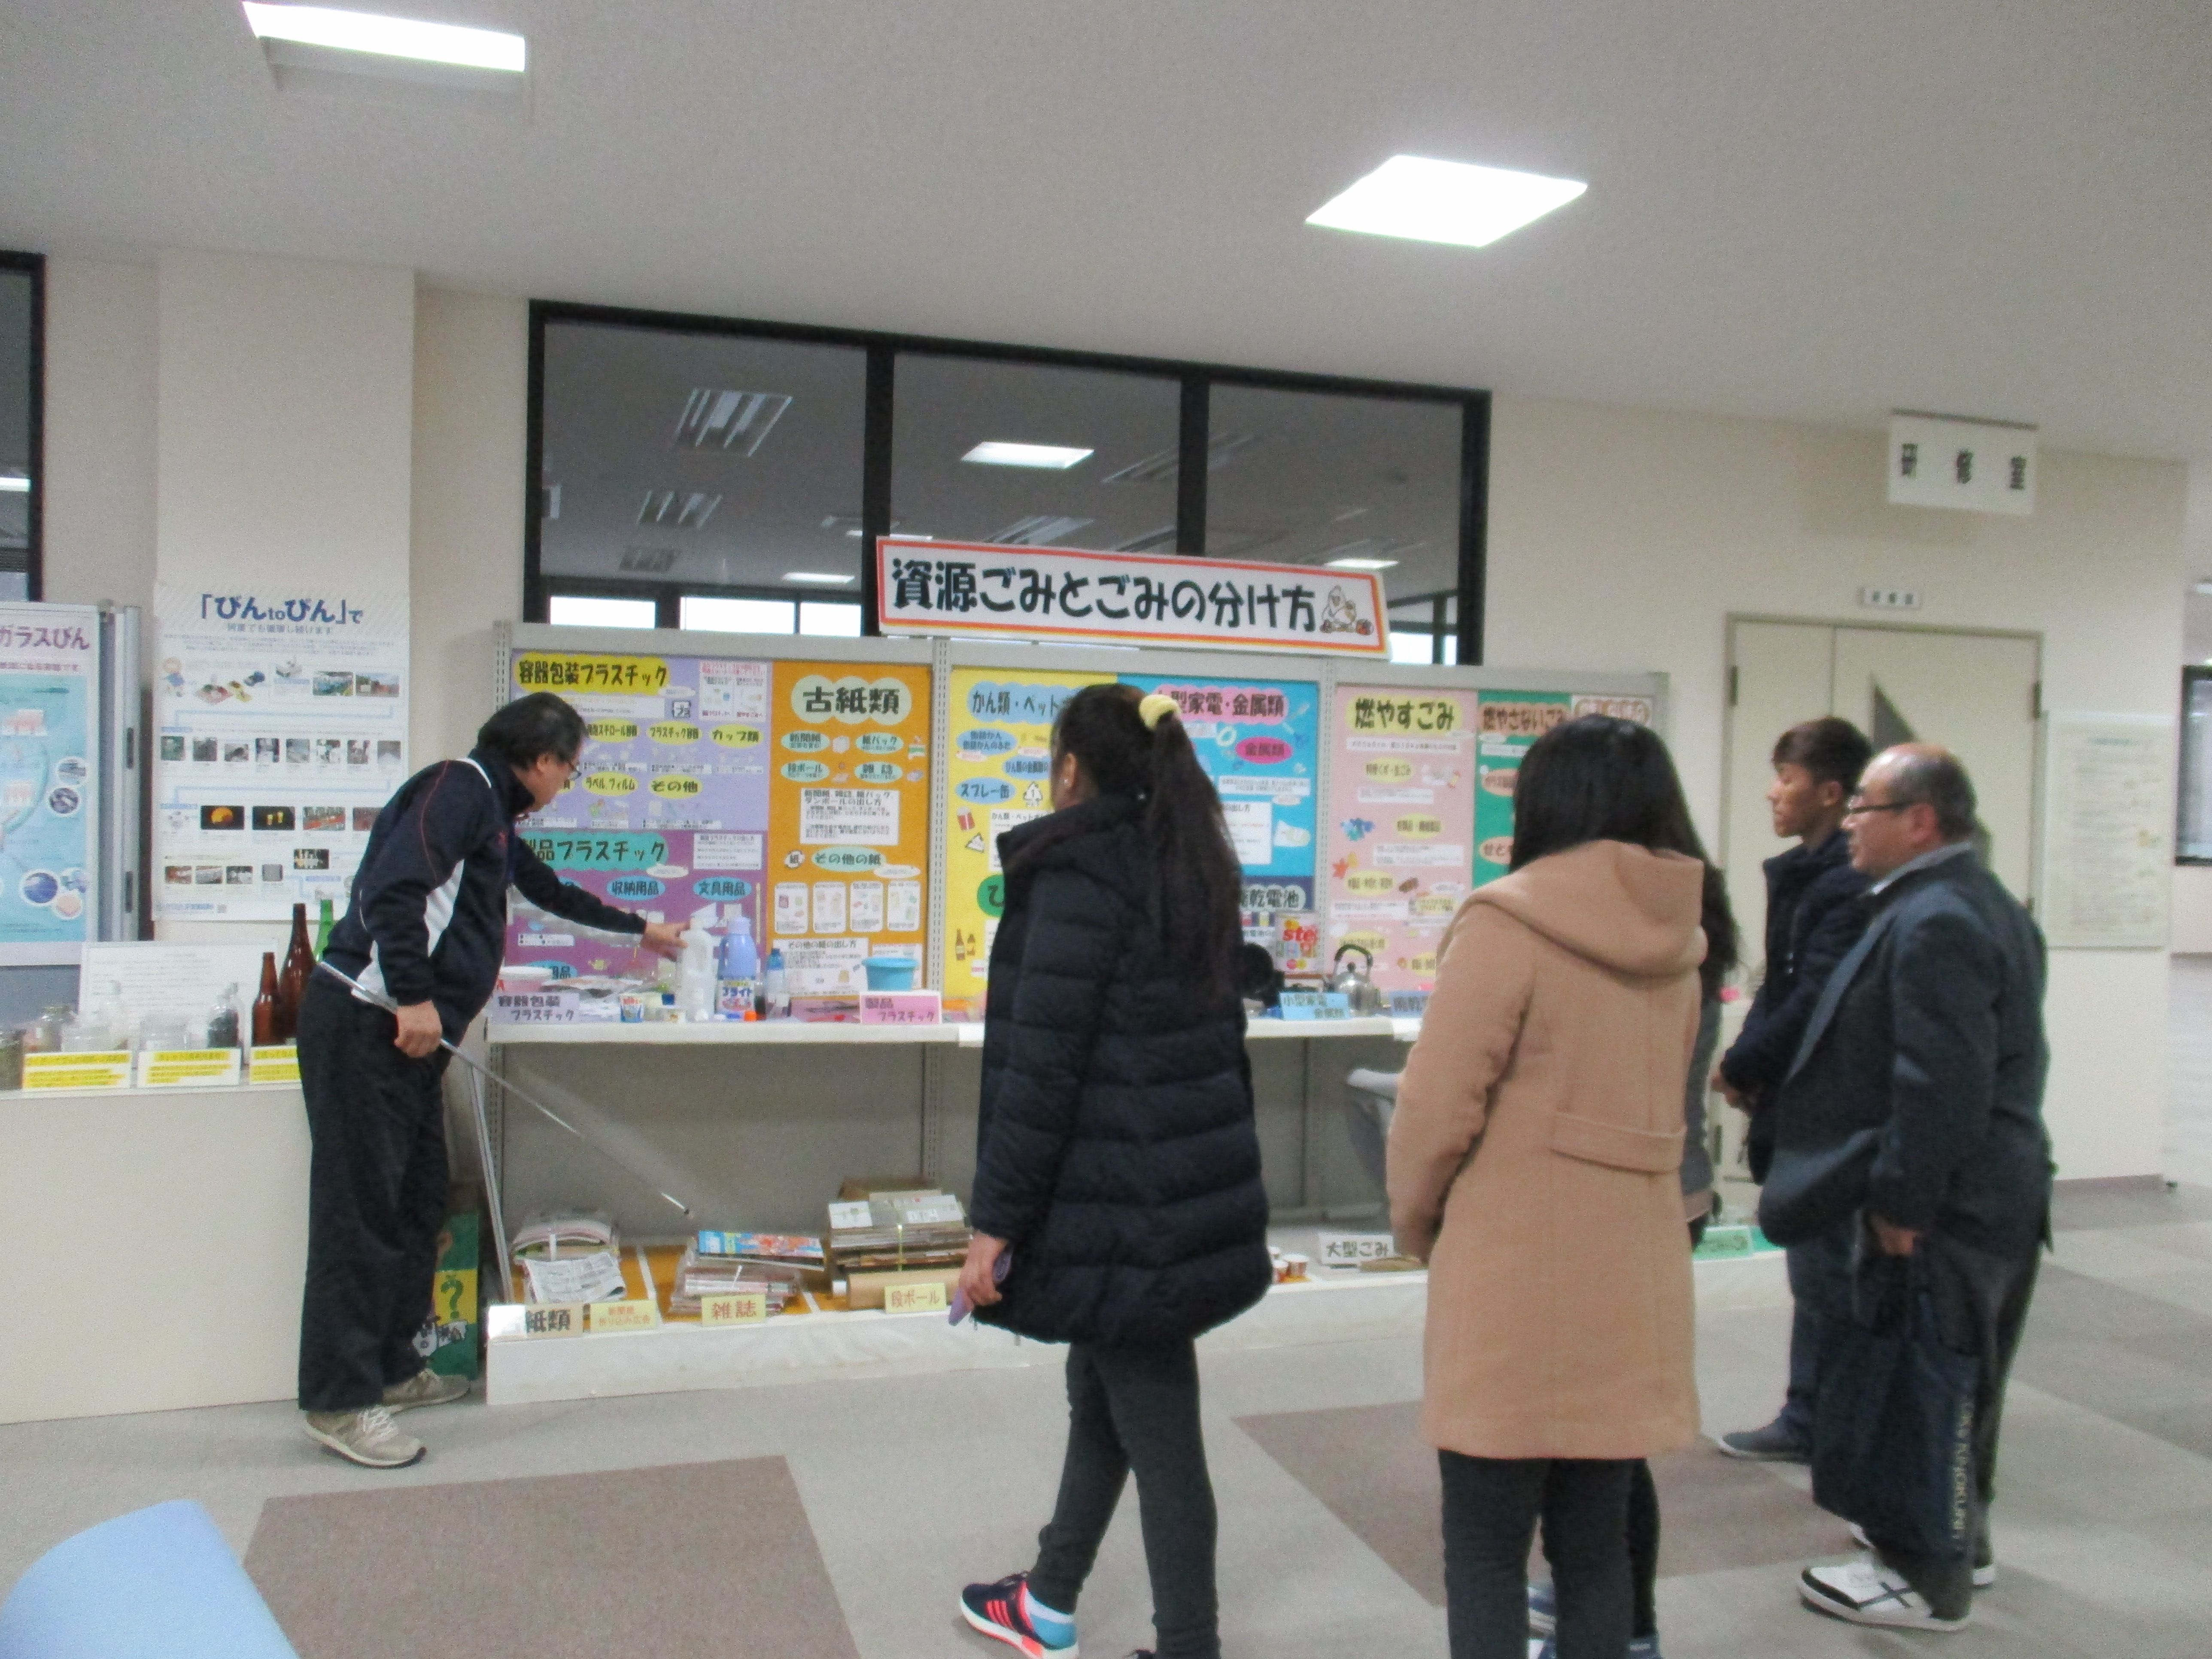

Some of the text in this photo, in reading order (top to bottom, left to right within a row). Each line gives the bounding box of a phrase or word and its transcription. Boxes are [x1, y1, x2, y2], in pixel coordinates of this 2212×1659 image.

[892, 558, 1316, 632] 資源ごみとごみの分け方
[201, 592, 364, 626] 「びんtoびん」で
[519, 660, 667, 687] 容器包装プラスチック
[802, 686, 899, 714] 古紙類
[972, 690, 1058, 716] かん類・ペット
[1159, 690, 1284, 717] 型家電・金属類
[1355, 698, 1455, 730] 燃やすごみ
[651, 781, 699, 794] その他
[960, 784, 1010, 799] スプレー缶
[815, 853, 882, 866] その他の紙
[611, 881, 659, 895] 収納用品
[698, 881, 746, 896] 文具用品
[1326, 1242, 1389, 1258] 大型ごみ
[890, 1290, 940, 1308] 段ボール
